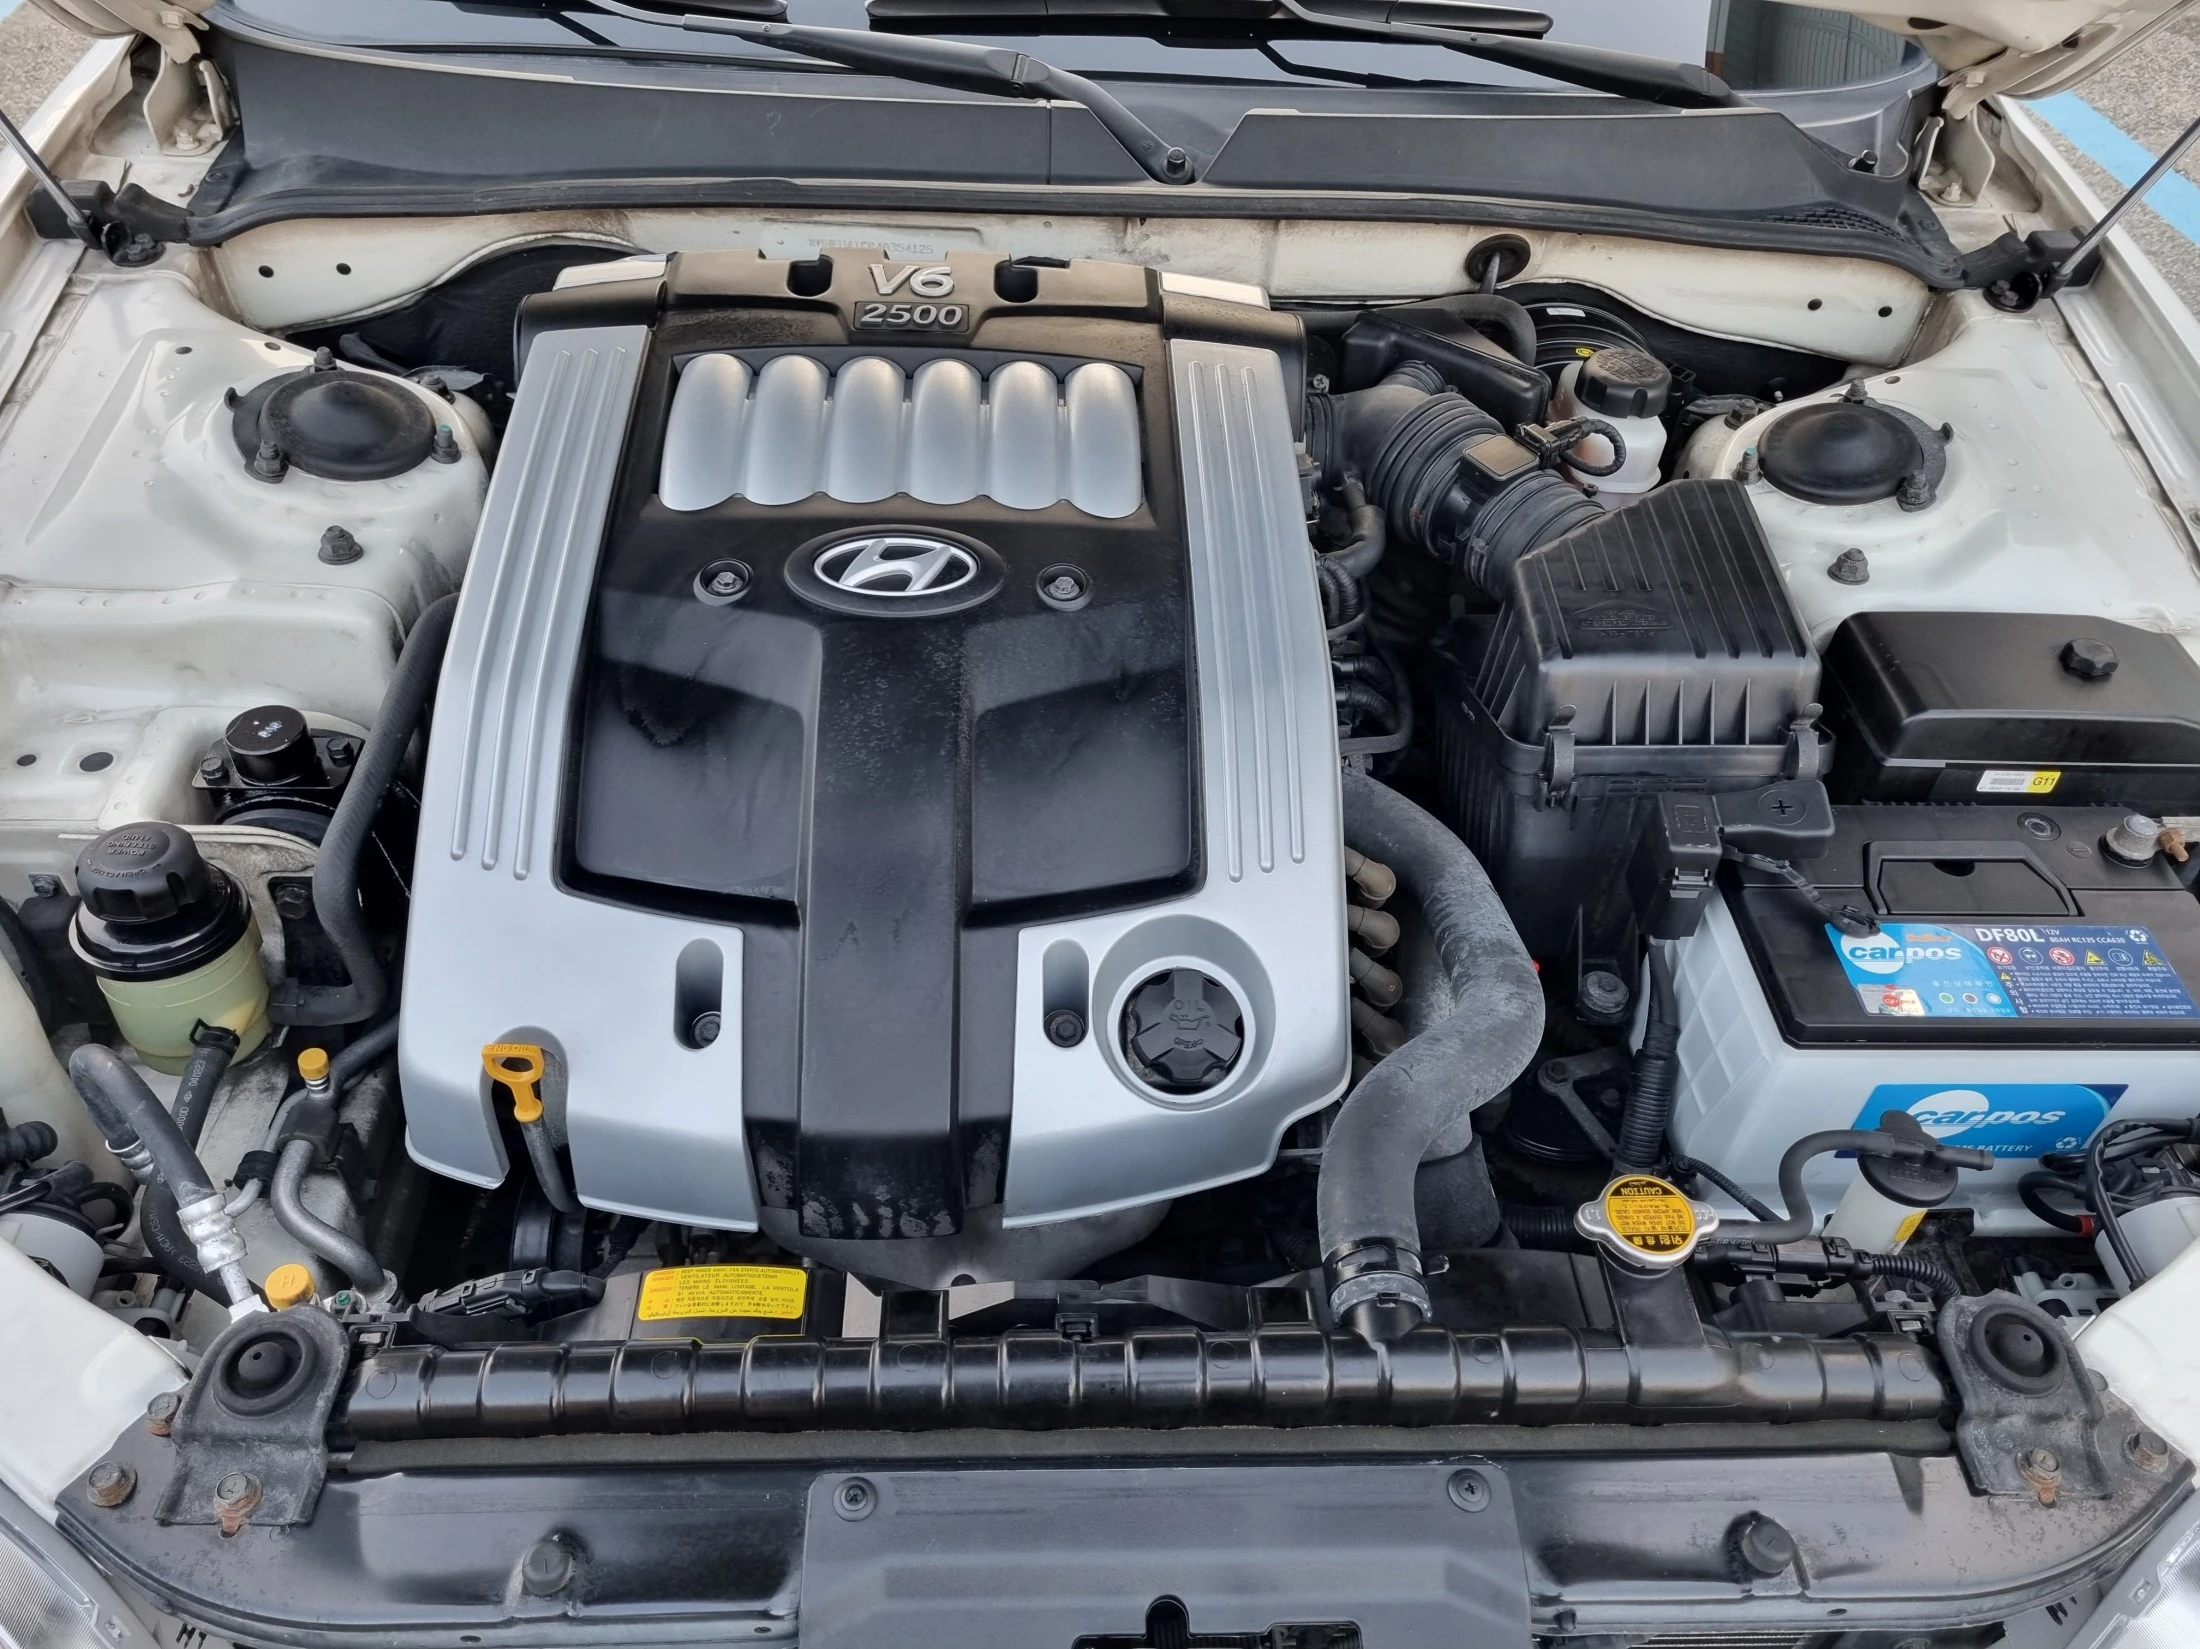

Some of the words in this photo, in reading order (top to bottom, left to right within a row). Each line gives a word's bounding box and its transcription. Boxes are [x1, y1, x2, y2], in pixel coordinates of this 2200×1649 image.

[870, 264, 954, 297] V6
[860, 304, 963, 326] 2500
[2033, 777, 2055, 786] G11
[106, 840, 156, 850] STEERING
[107, 848, 146, 856] POWER
[1975, 928, 2045, 944] DF80L
[1849, 946, 1962, 963] carpos
[1173, 1000, 1204, 1011] OIL
[1914, 1109, 2066, 1128] carpos
[1977, 1144, 2034, 1152] BATTERY
[1621, 1187, 1662, 1195] CAUTION
[1659, 1234, 1683, 1245] 위험
[281, 1273, 295, 1288] H
